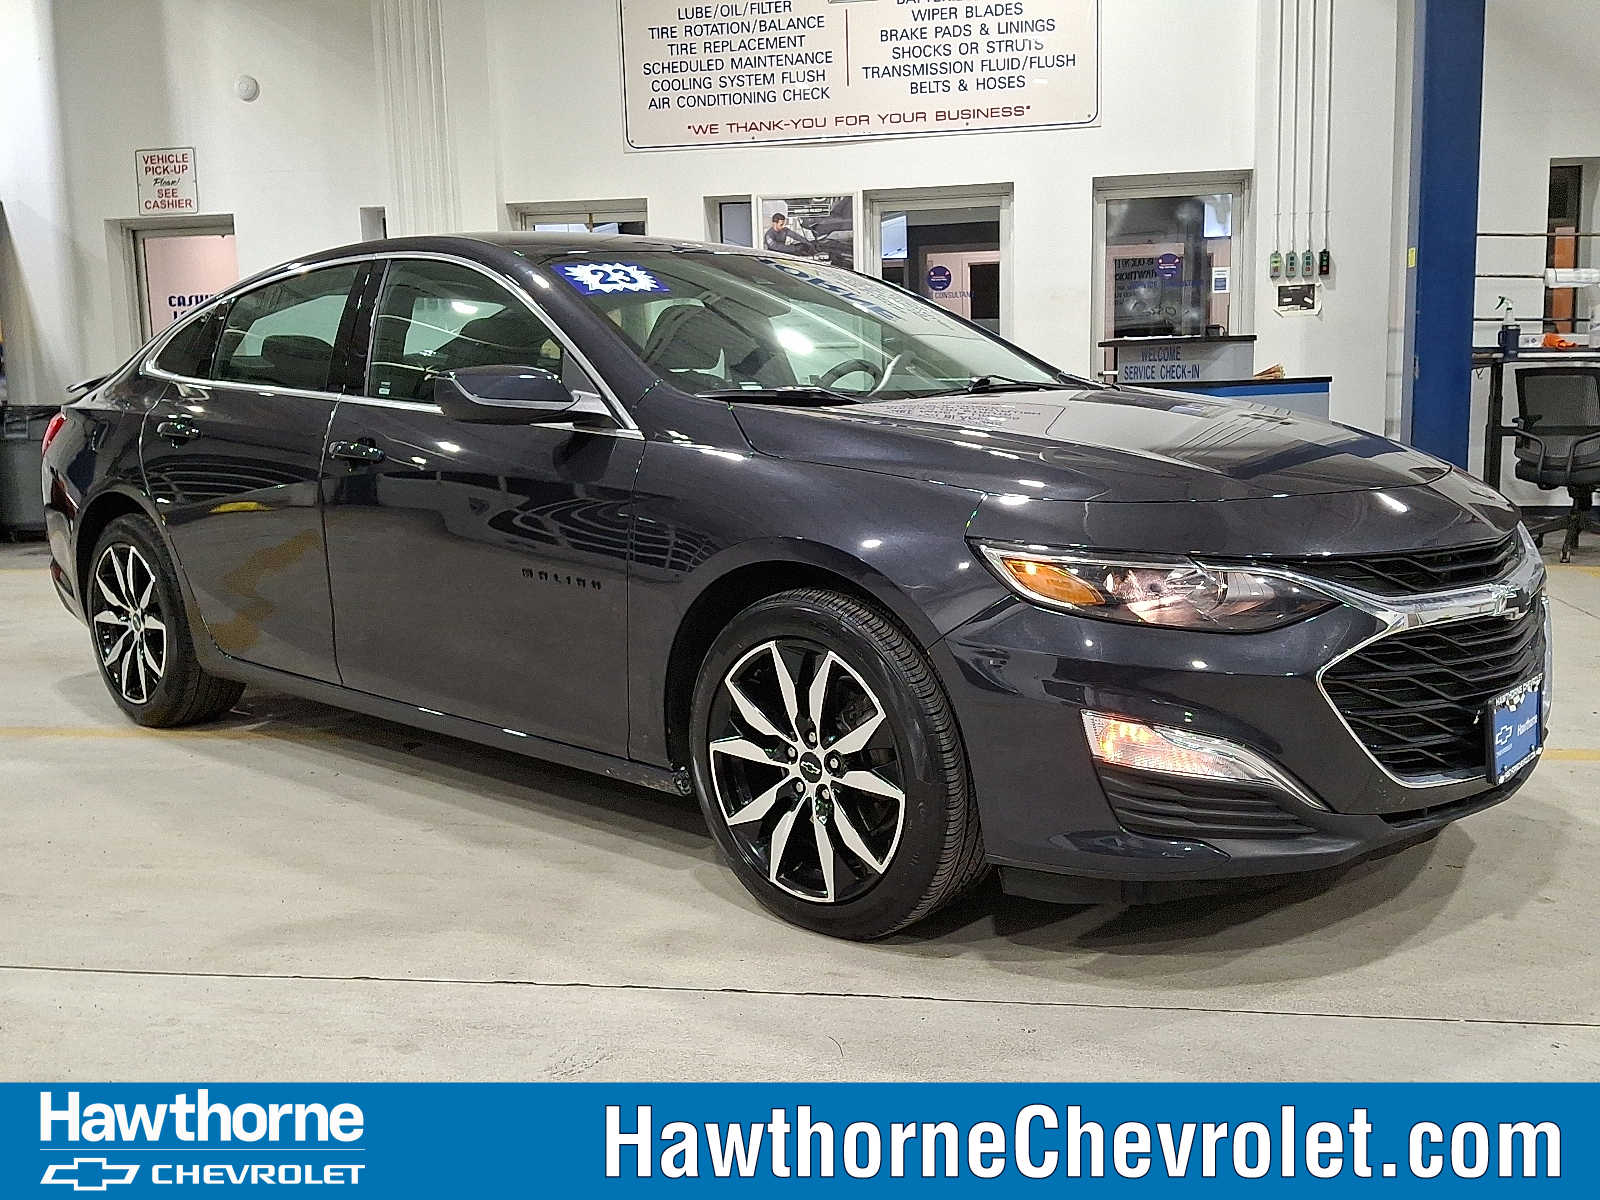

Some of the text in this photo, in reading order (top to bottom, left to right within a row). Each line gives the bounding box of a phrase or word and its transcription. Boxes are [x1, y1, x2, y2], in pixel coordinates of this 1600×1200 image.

[677, 0, 792, 20] LUBE/OIL/FILTER
[912, 2, 1023, 22] WIPER BLADES
[648, 16, 825, 40] TIRE ROTATION/BALANCE
[880, 18, 1056, 42] BRAKE PADS & LININGS
[668, 35, 806, 56] TIRE REPLACEMENT
[892, 38, 1044, 59] SHOCKS OR STRUTS
[643, 51, 833, 75] SCHEDULED MAINTENANCE
[862, 54, 1076, 79] TRANSMISSION FLUID/FLUSH
[651, 69, 826, 93] COOLING SYSTEM FLUSH
[910, 75, 1026, 94] BELTS & HOSES
[648, 87, 831, 110] AIR CONDITIONING CHECK
[726, 117, 827, 133] THANK-YOU
[835, 115, 870, 127] FOR
[878, 111, 927, 125] YOUR
[143, 153, 189, 165] VEHICLE
[145, 164, 188, 175] PICK-UP
[157, 188, 179, 199] SEE
[144, 199, 193, 209] CASHIER
[590, 269, 638, 284] 23
[1141, 345, 1182, 362] WELCOME
[1124, 364, 1200, 380] SERVICE CHECK-IN
